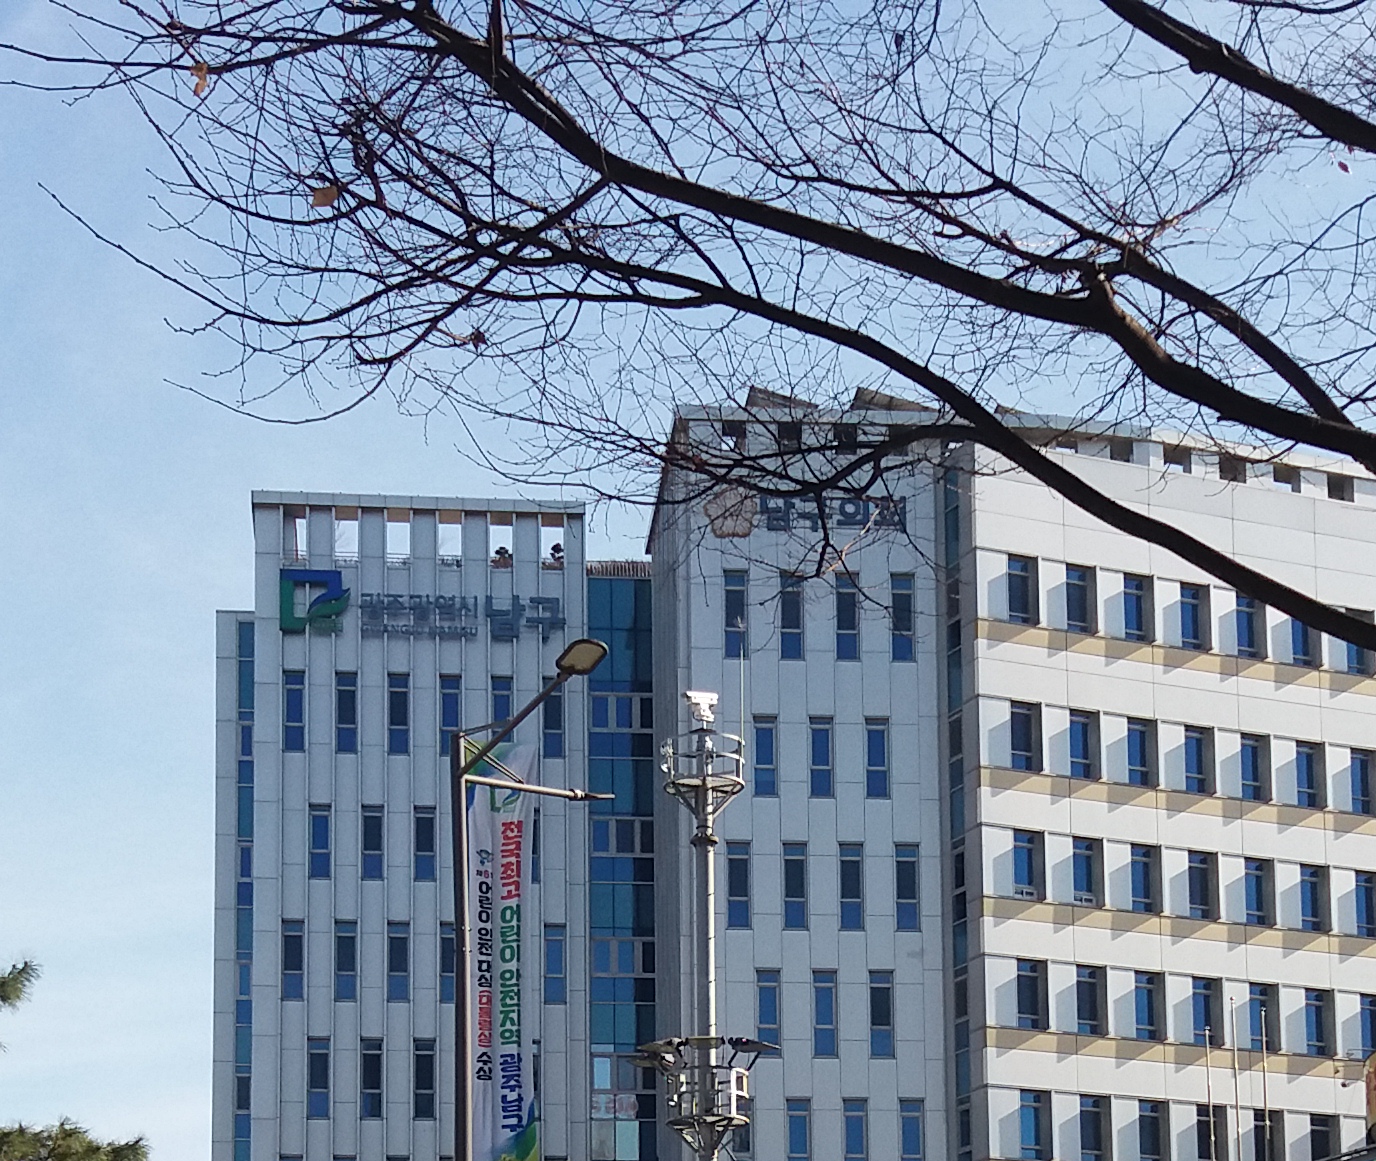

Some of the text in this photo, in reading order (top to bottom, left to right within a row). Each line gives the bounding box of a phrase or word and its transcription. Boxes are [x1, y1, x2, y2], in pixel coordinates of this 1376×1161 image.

[485, 593, 566, 643] 남구
[498, 819, 524, 1133] 전국최고 어린이 안전지역 광주남구
